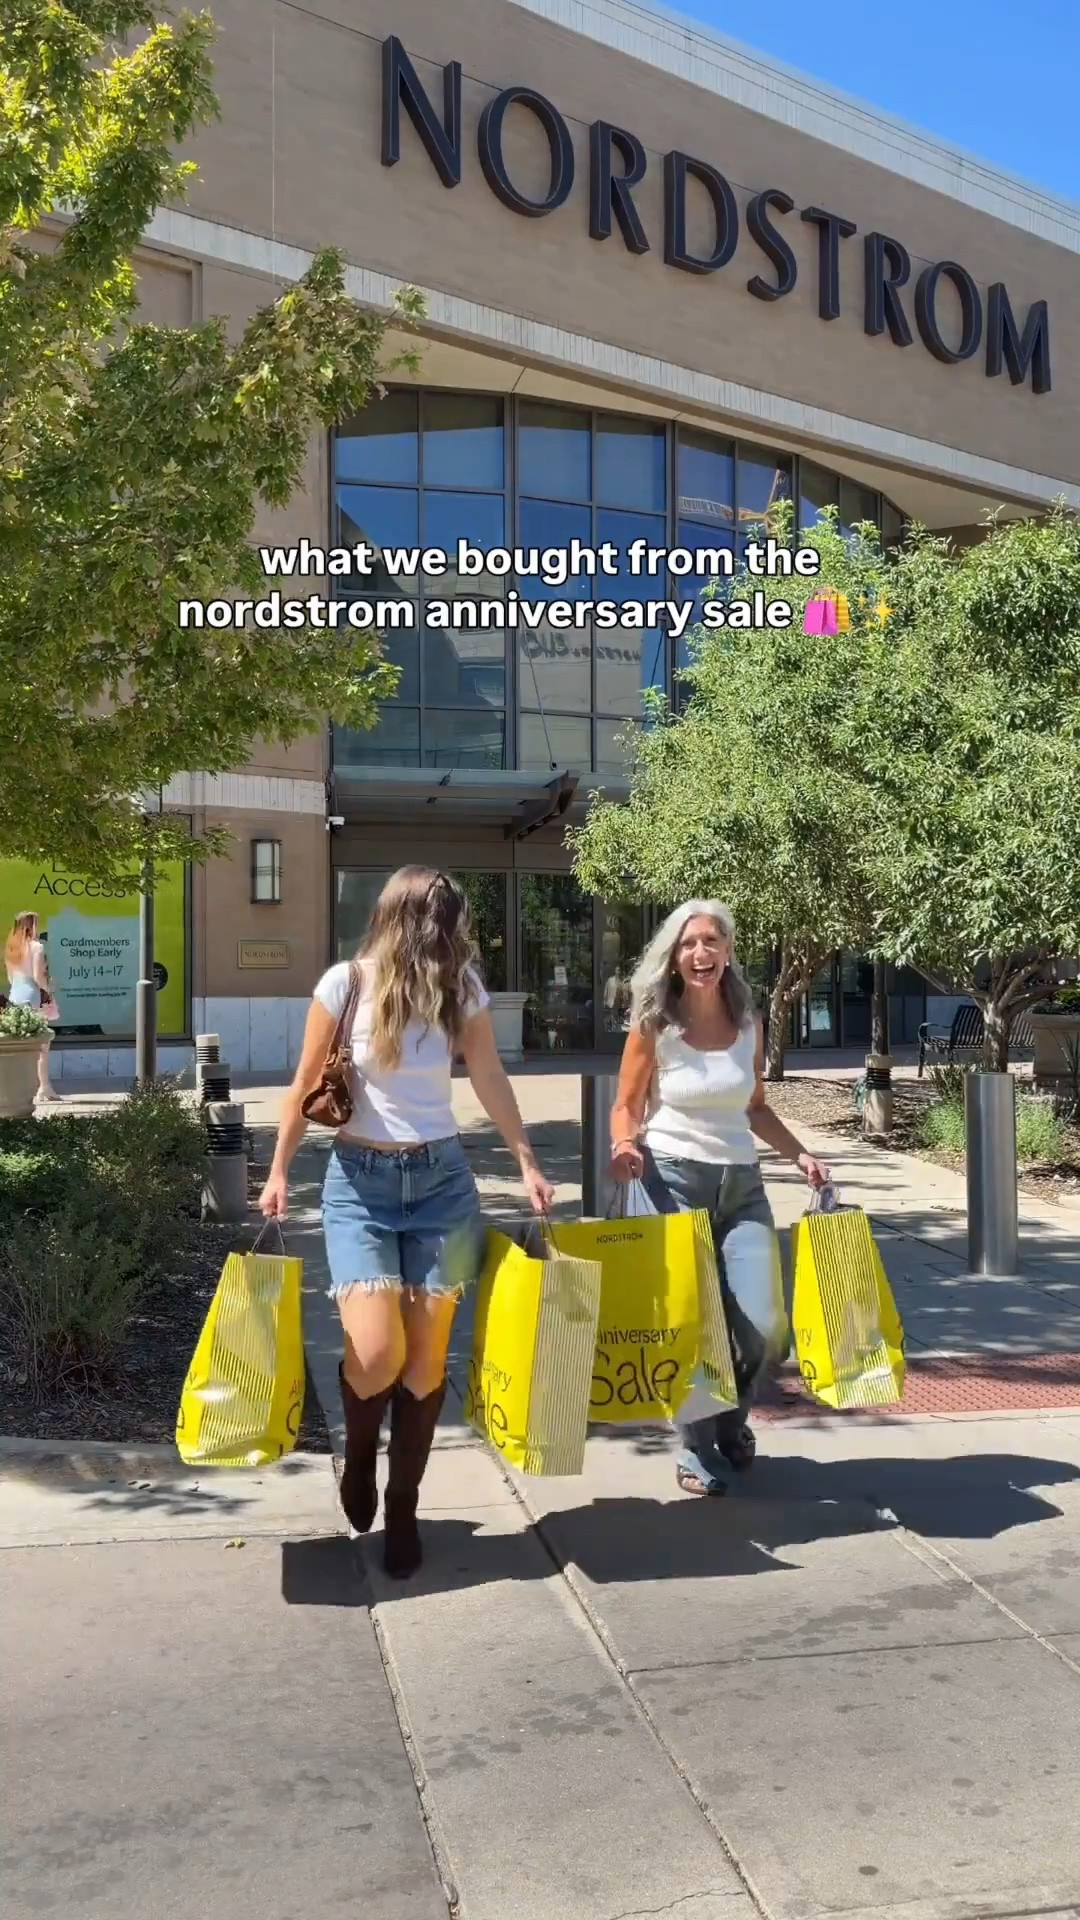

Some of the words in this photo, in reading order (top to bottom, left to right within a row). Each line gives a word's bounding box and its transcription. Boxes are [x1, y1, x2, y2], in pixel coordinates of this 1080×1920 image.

[381, 35, 1052, 394] NORDSTROM
[60, 937, 130, 947] Cardmembers
[70, 948, 95, 958] Shop
[98, 948, 121, 958] Early
[68, 965, 91, 980] July
[599, 1325, 682, 1347] niversary
[589, 1346, 680, 1407] Sale
